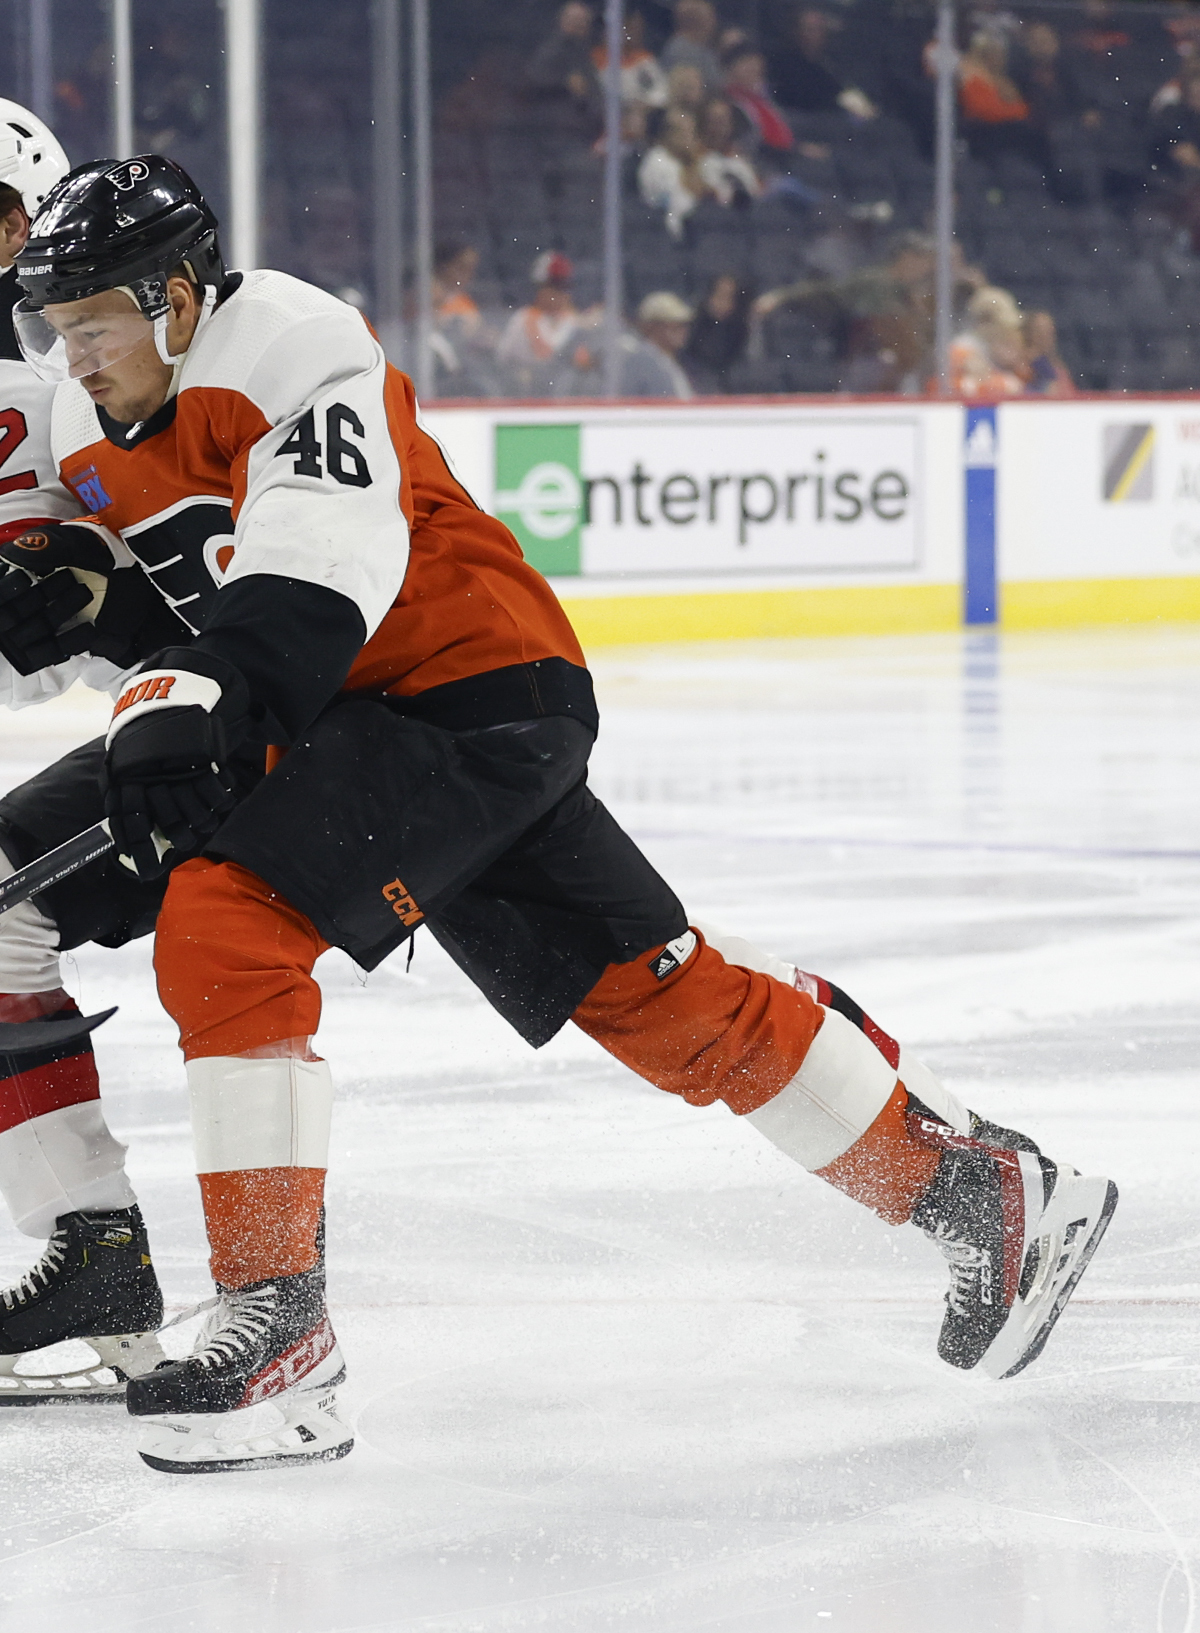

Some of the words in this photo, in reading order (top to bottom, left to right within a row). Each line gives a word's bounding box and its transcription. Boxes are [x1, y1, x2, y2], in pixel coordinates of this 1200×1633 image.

[18, 264, 53, 276] BAUER
[274, 402, 373, 489] 46
[497, 450, 910, 547] enterprise
[381, 877, 425, 927] CCM
